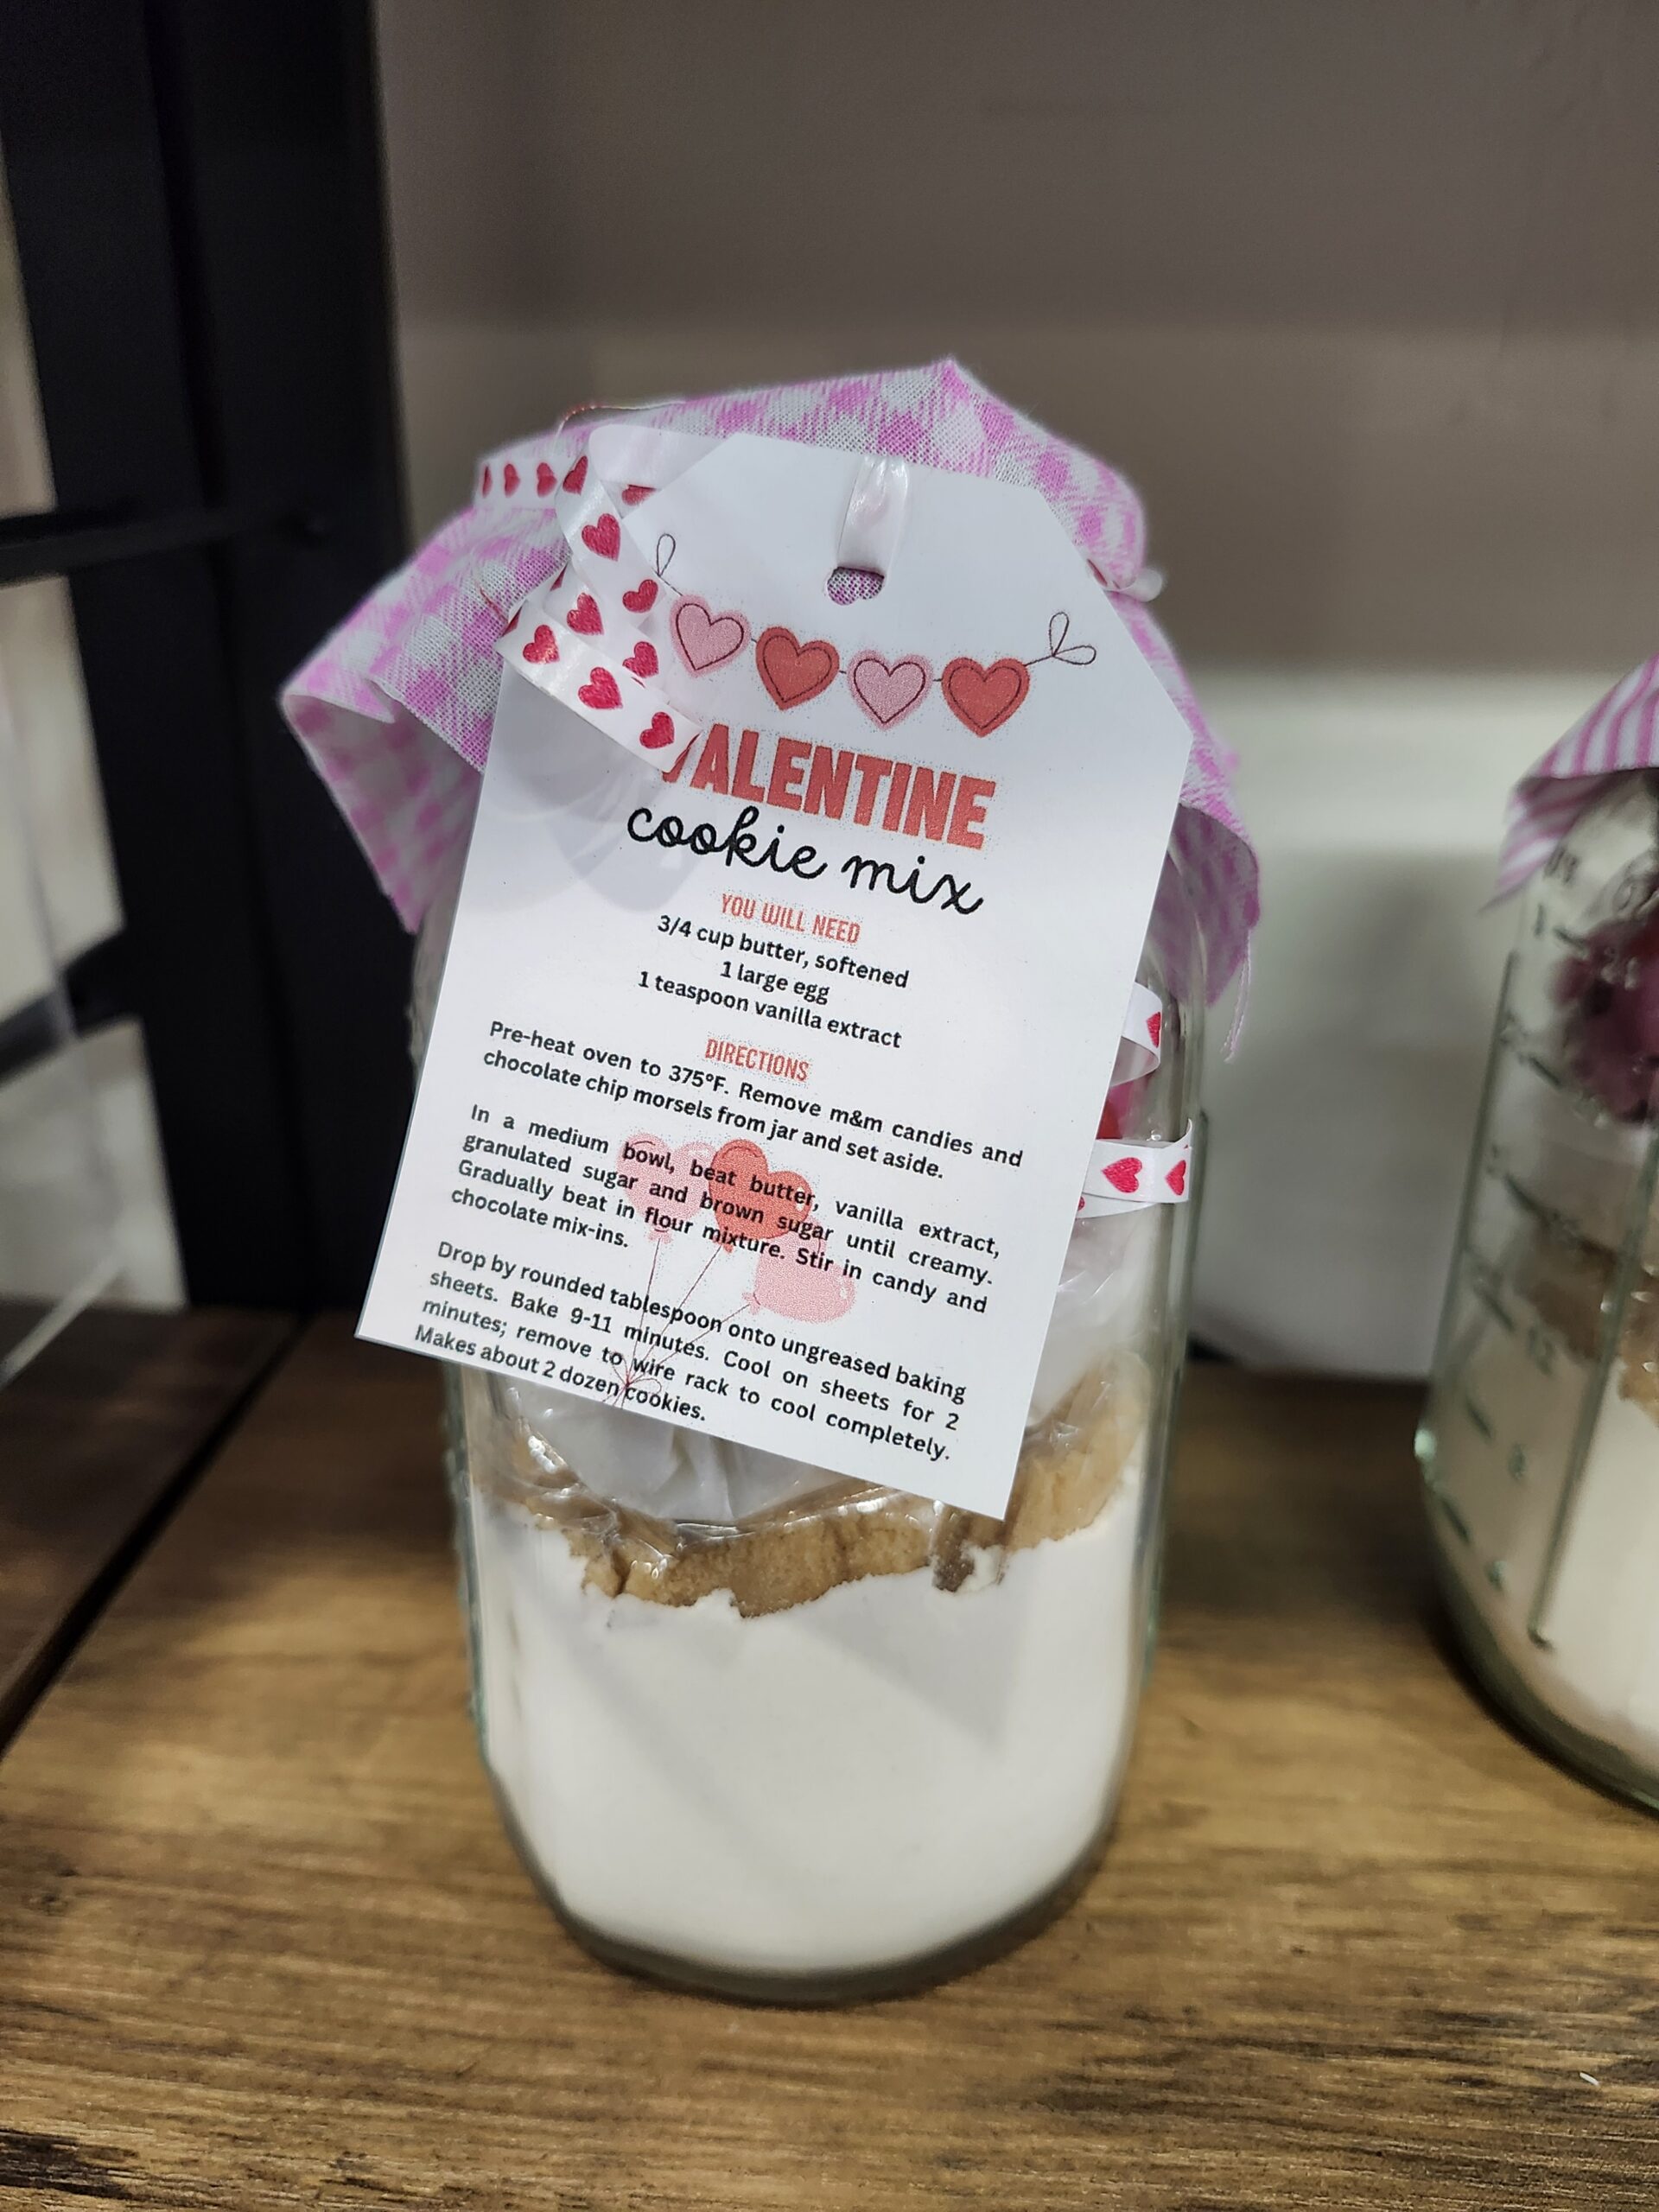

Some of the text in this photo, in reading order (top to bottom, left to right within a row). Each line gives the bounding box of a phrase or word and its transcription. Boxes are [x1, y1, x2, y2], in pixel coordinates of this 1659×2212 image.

[626, 804, 984, 915] cookie mix
[722, 893, 861, 944] YOU WILL NEED
[638, 970, 902, 1049] 1 teaspoon vanilla extract
[657, 914, 910, 988] 3/4 cup butter, softened
[720, 960, 830, 1006] 1 large egg
[483, 1049, 944, 1179] chocolate chip morsels from jar and set aside.
[489, 1020, 576, 1057] Pre-heat
[582, 1047, 632, 1071] oven
[640, 1058, 661, 1077] to
[738, 1082, 822, 1117] Remove
[830, 1108, 883, 1133] m&m
[892, 1123, 974, 1155] candies
[982, 1146, 1024, 1167] and
[706, 1039, 808, 1082] DIRECTIONS
[451, 1187, 628, 1248] chocolate mix-ins.
[458, 1159, 988, 1314] Gradually beat in flour mixture. Stir in candy and
[462, 1135, 993, 1286] granulated sugar and brown sugar until creamy.
[471, 1103, 1000, 1260] In a medium bowl, beat butter, vanilla extract,
[415, 1324, 706, 1421] Makes about 2 dozen cookies.
[422, 1300, 950, 1462] minutes; remove to wire rack to cool completely.
[429, 1270, 960, 1431] sheets. Bake 9-11 minutes. Cool on sheets for 2
[437, 1241, 967, 1406] Drop by rounded tablespoon onto ungreased baking
